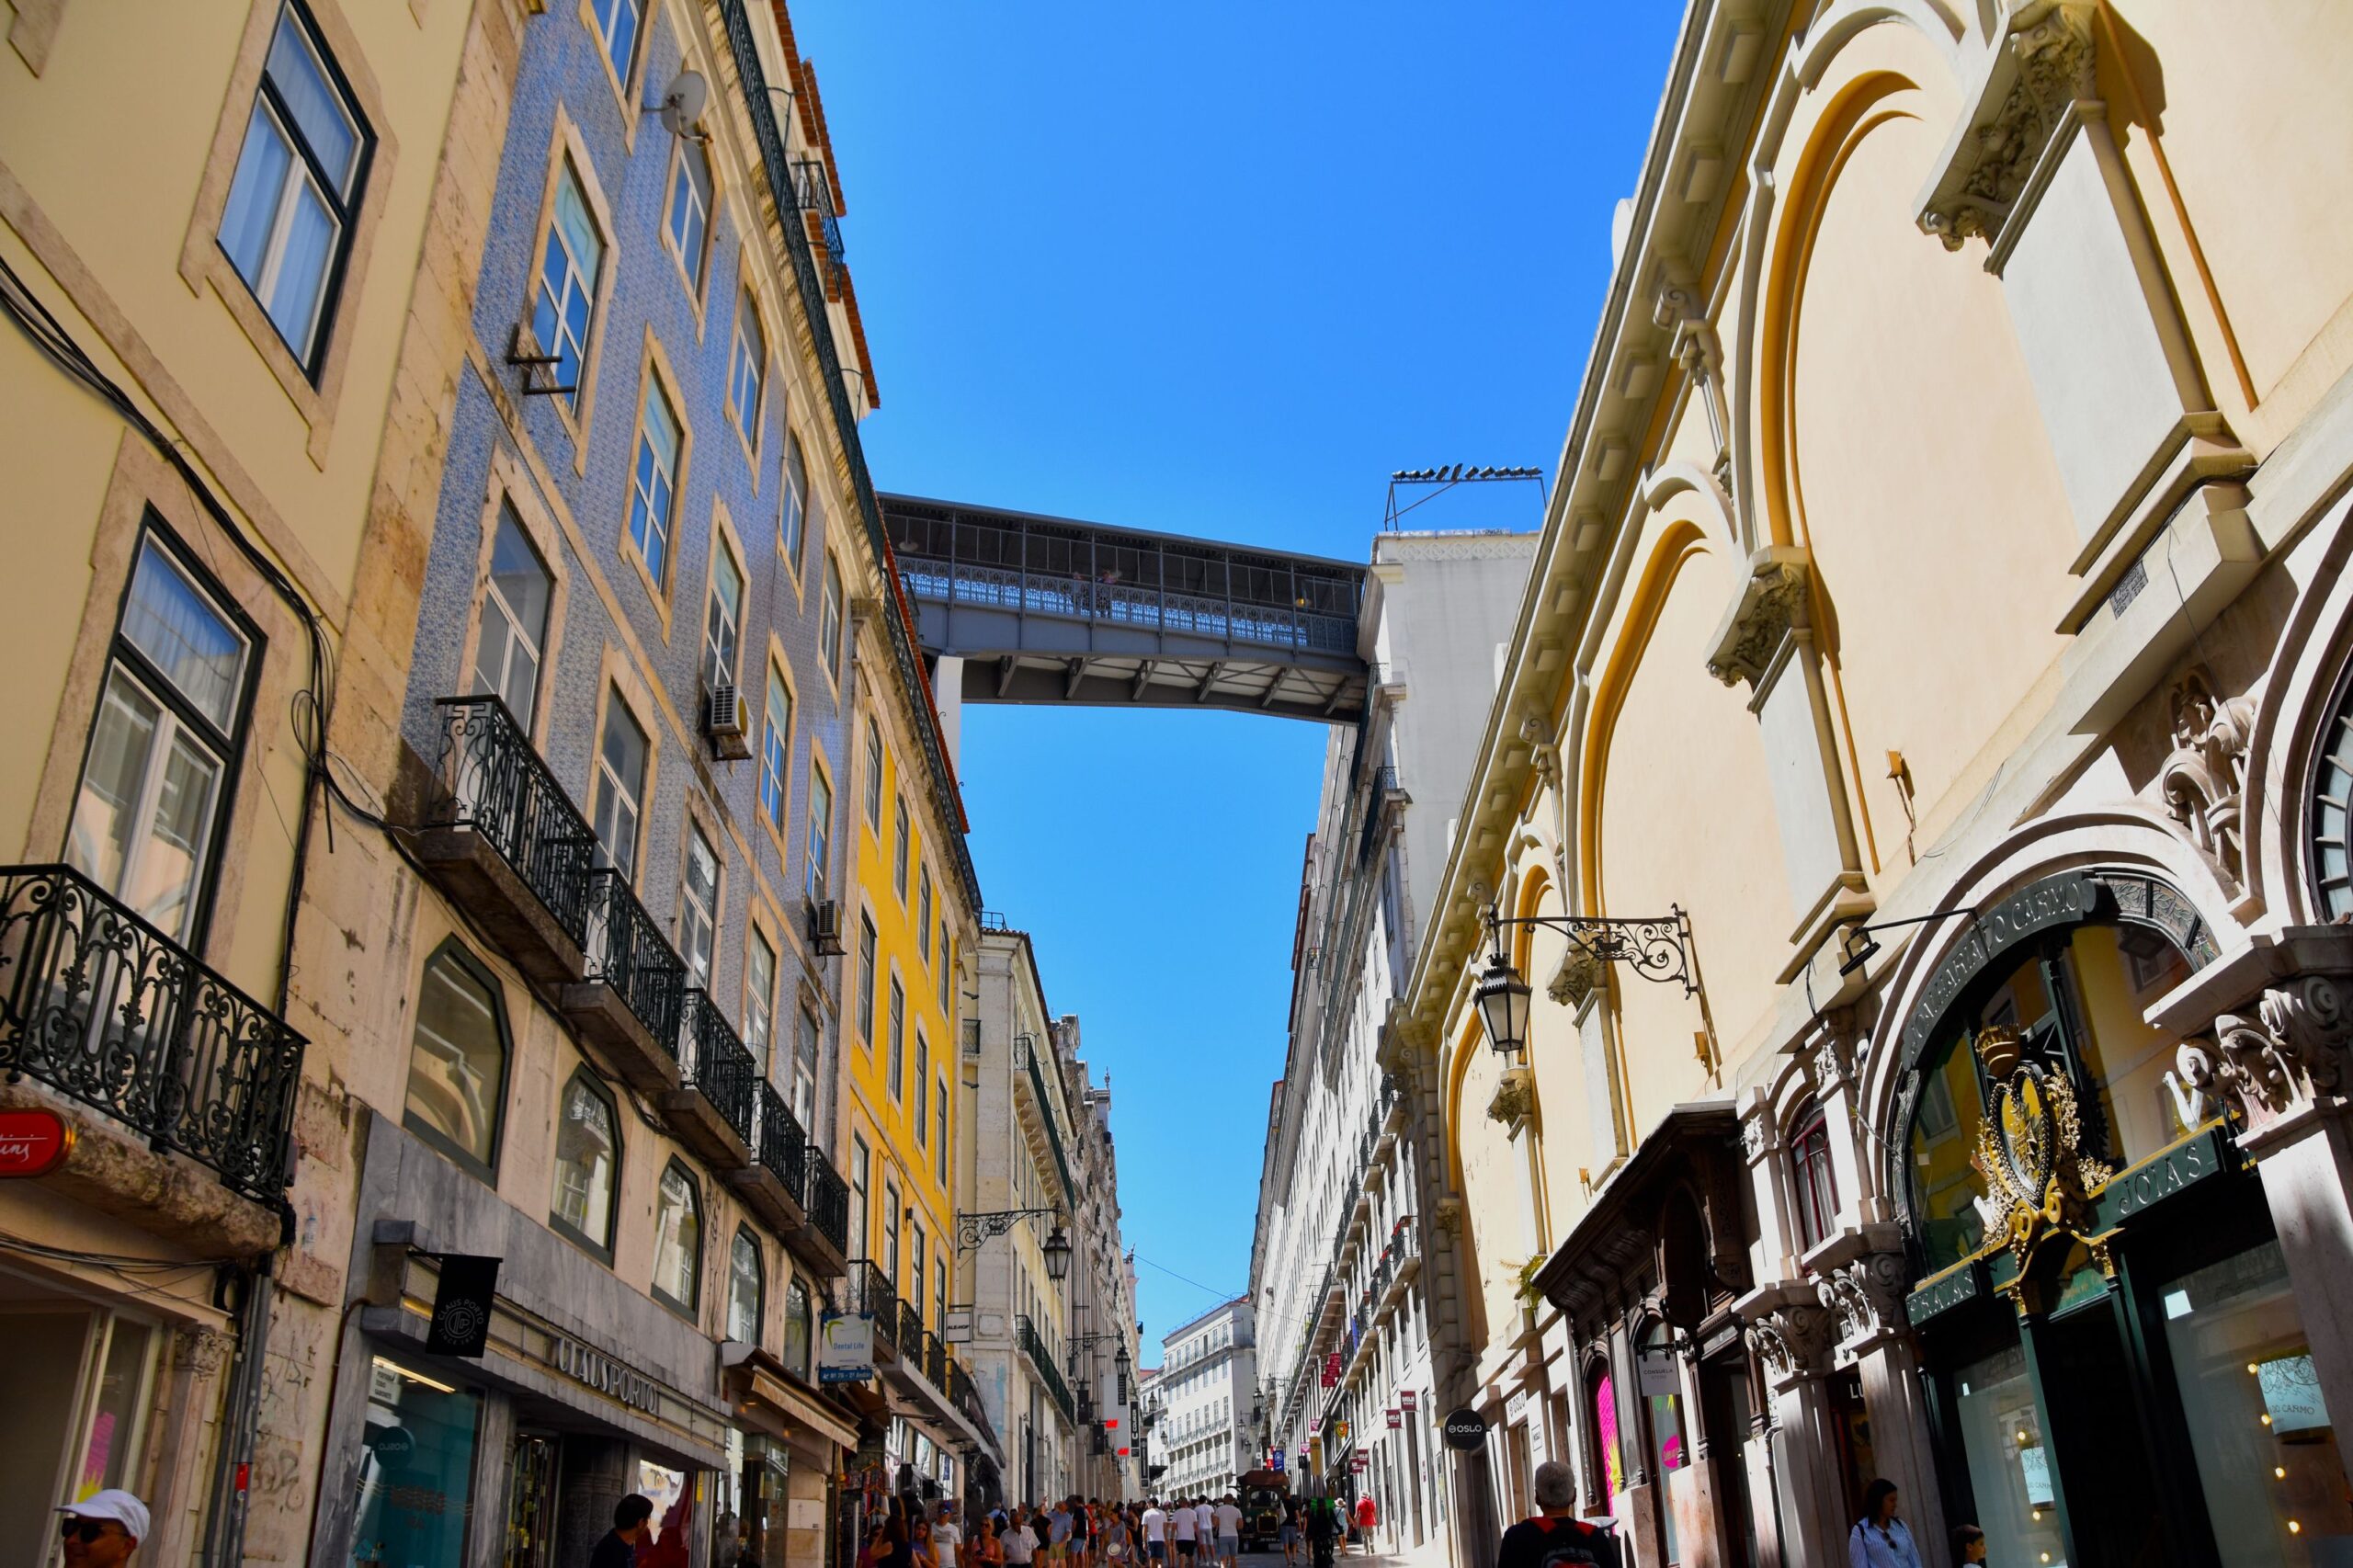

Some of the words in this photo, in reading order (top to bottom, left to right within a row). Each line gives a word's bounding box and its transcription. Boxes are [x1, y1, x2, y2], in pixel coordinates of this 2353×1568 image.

[2011, 882, 2080, 931] CARMO
[1907, 1269, 1975, 1324] PRATAS
[438, 1299, 462, 1321] CLAUS
[463, 1299, 484, 1324] PORTO
[2281, 1403, 2315, 1415] CARMO
[1457, 1425, 1483, 1433] OSLO
